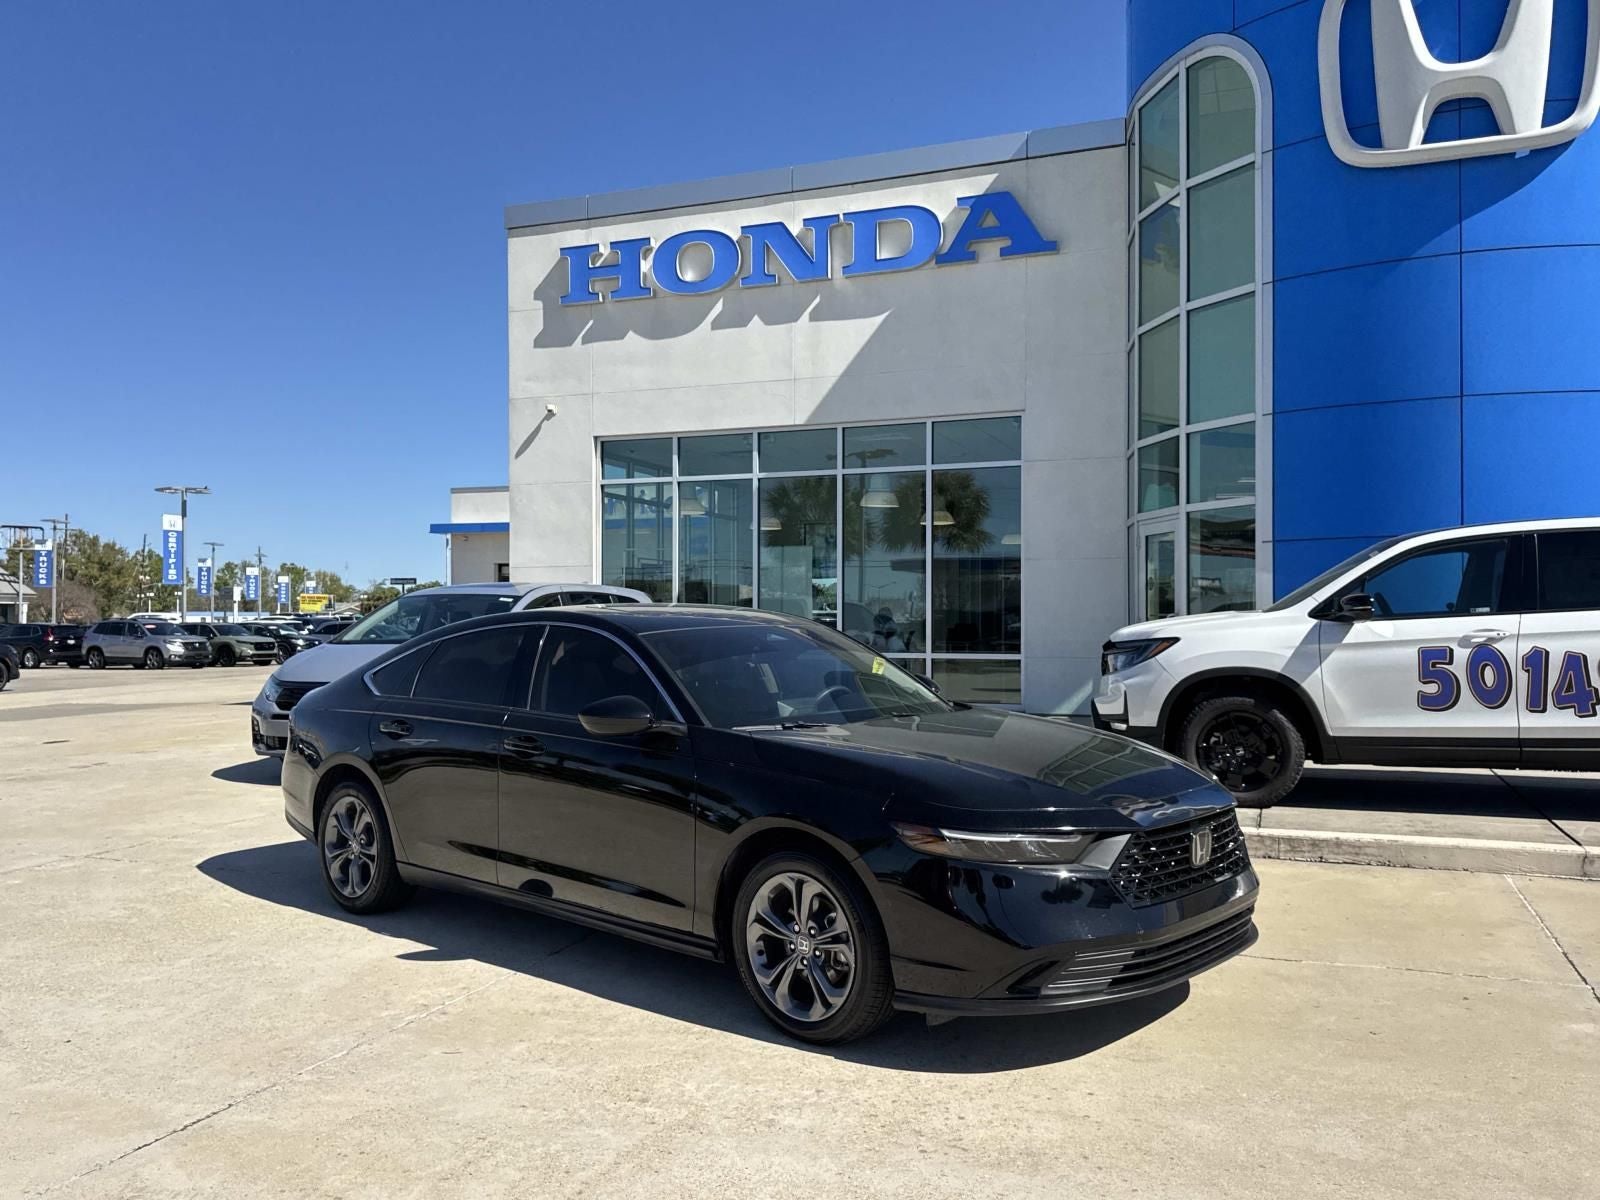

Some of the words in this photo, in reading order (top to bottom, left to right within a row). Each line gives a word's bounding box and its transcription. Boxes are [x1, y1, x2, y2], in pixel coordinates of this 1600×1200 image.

[559, 190, 1059, 306] HONDA
[39, 550, 48, 585] TRUCKS
[168, 531, 177, 580] CERTIFIED
[1416, 643, 1600, 719] 5014
